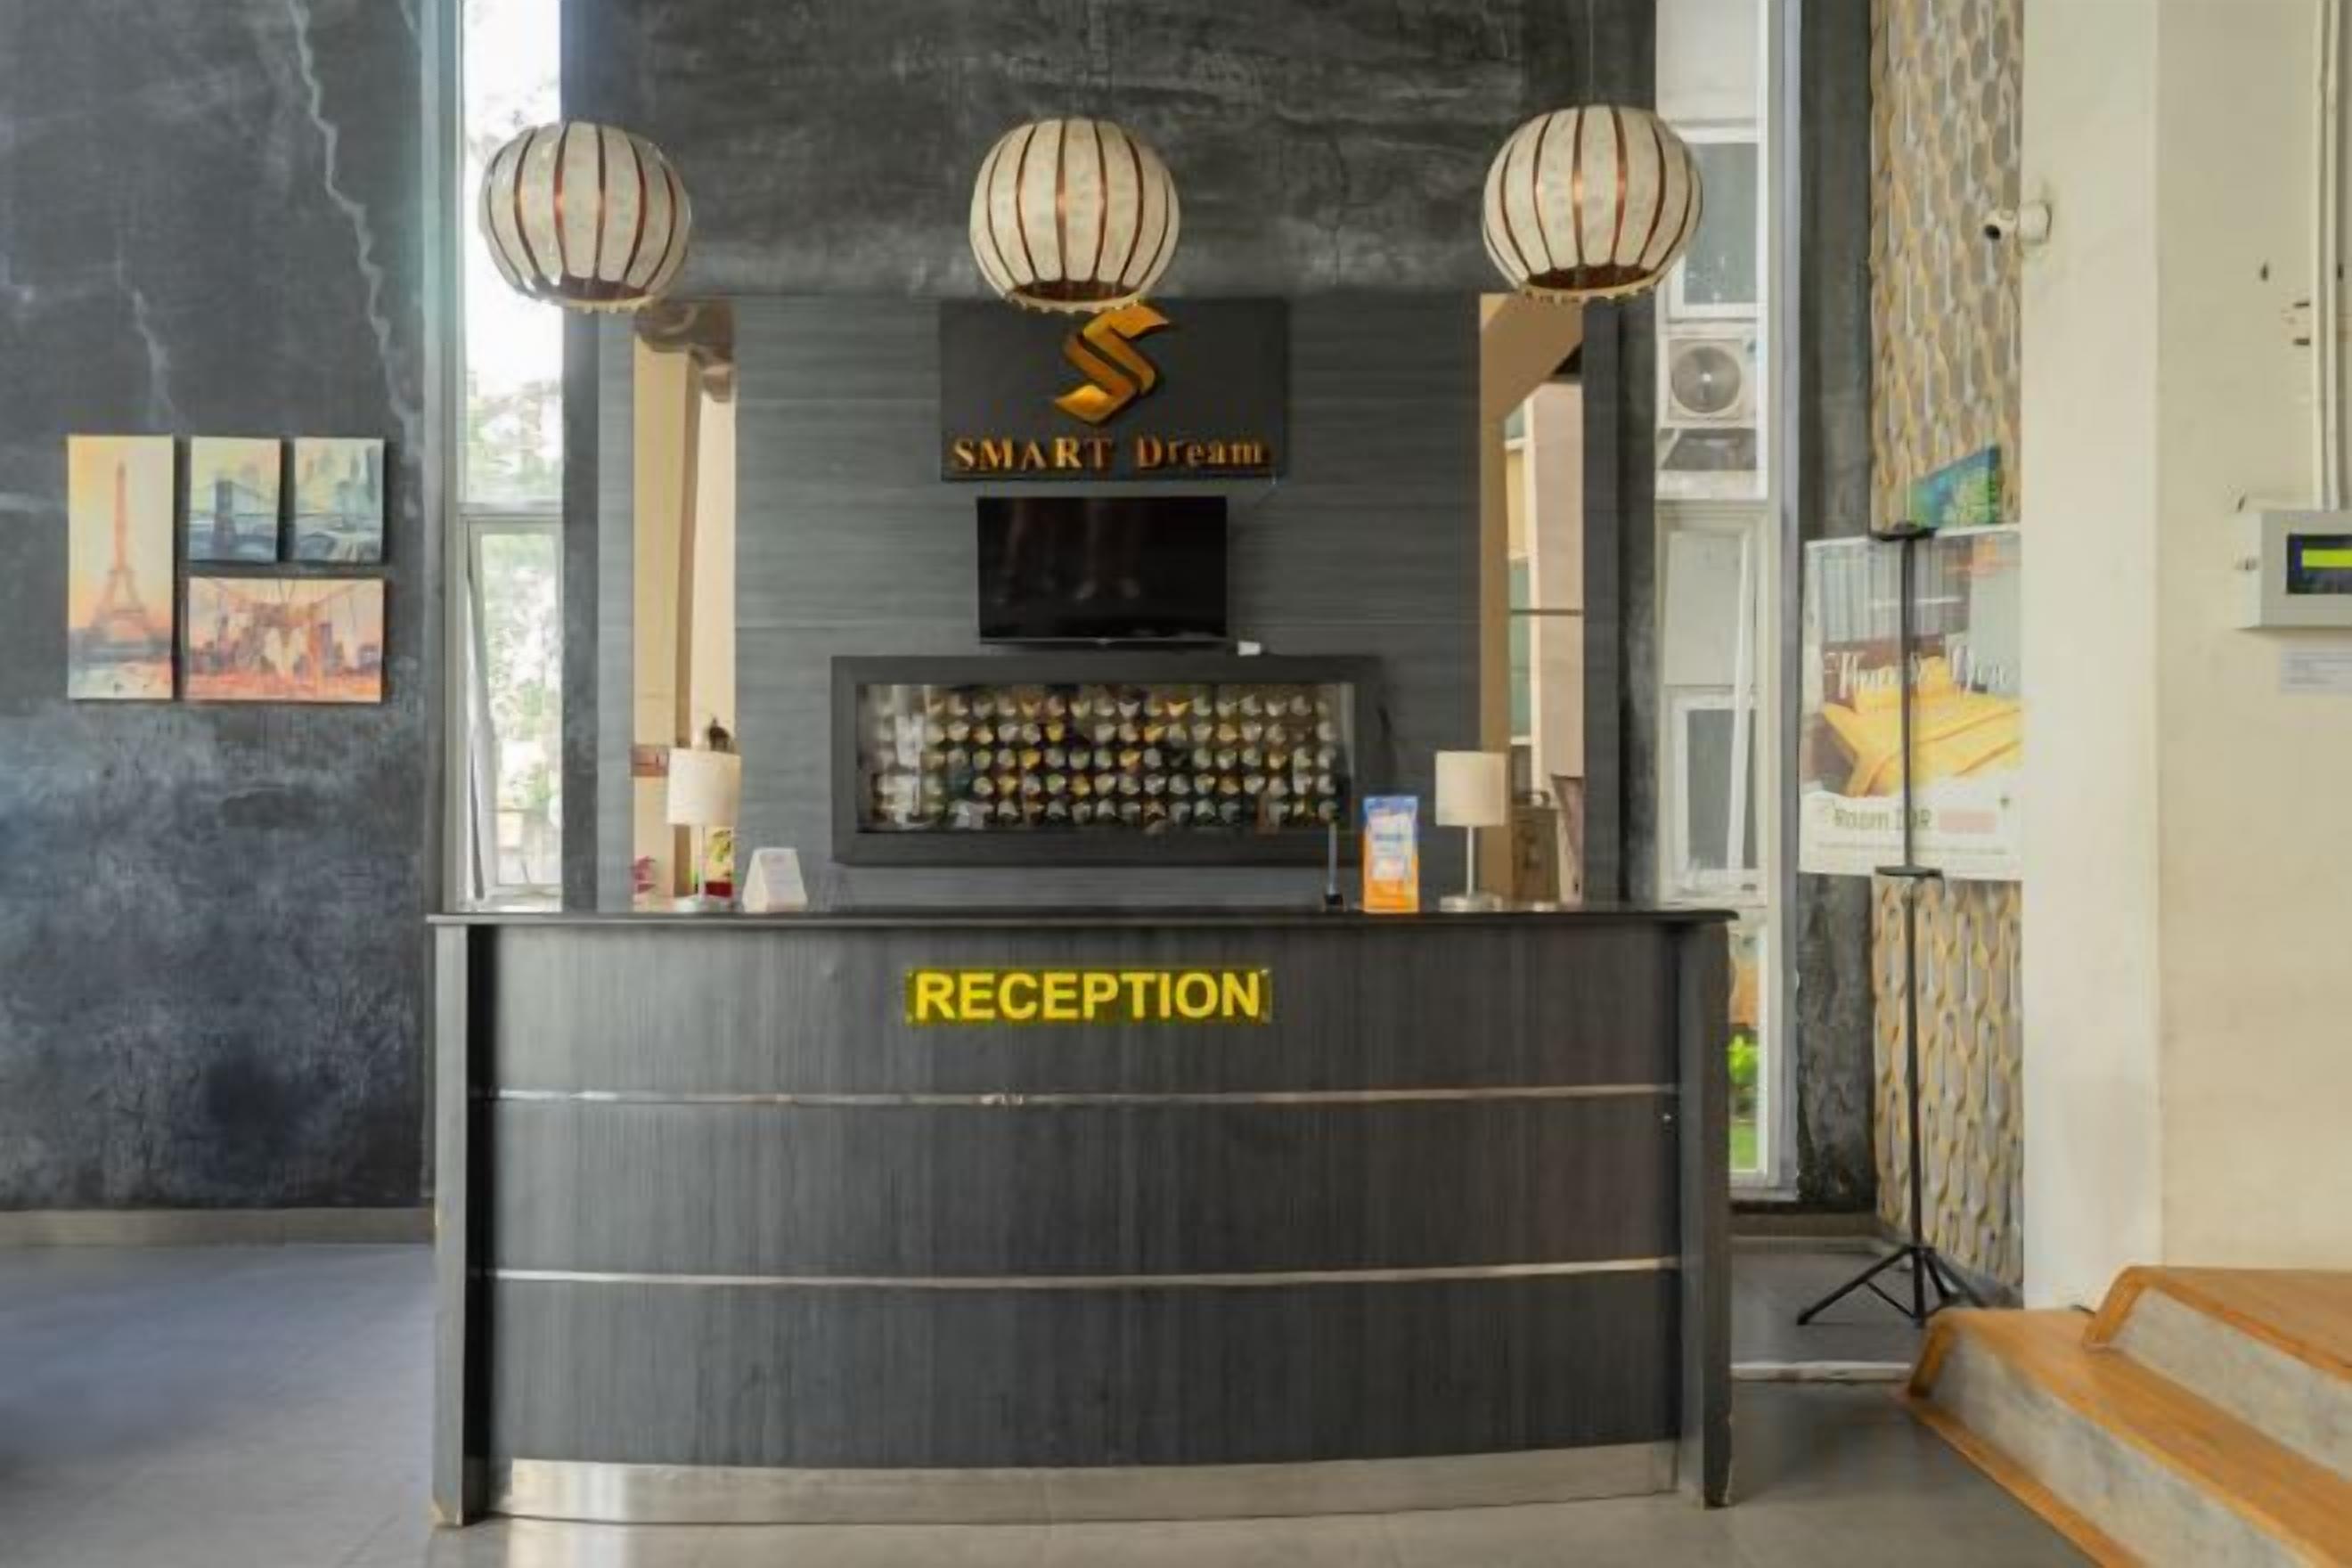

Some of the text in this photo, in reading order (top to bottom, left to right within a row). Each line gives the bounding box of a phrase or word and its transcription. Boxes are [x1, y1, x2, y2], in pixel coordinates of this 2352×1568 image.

[953, 435, 1263, 470] SMART Dream
[914, 972, 1260, 1020] RECEPTION
